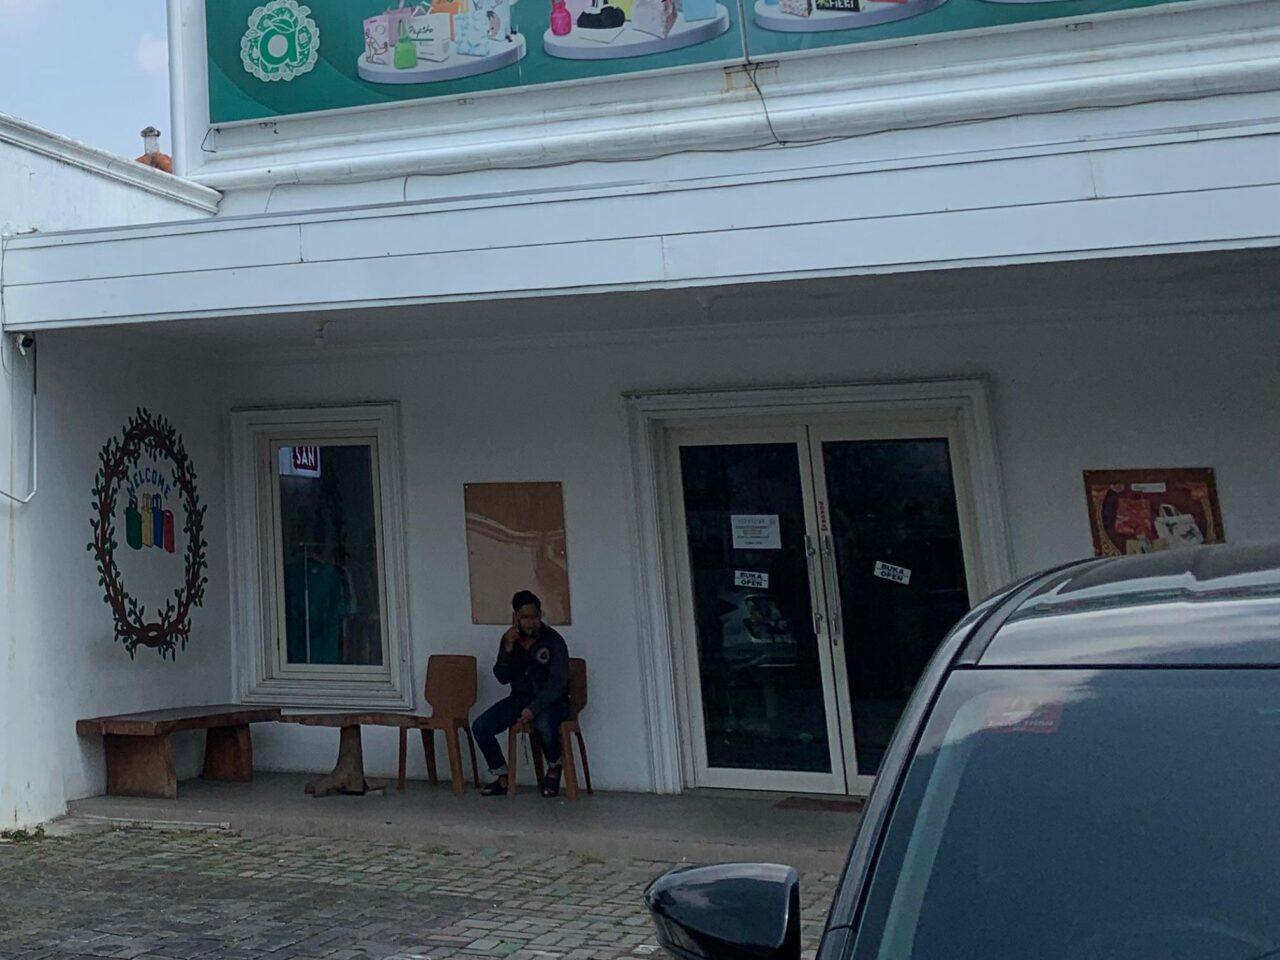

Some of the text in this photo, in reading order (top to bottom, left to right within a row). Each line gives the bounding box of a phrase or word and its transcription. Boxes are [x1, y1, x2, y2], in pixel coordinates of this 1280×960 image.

[295, 446, 315, 467] SAN
[126, 467, 171, 501] WELCOME
[881, 564, 904, 574] BUKA
[740, 572, 762, 580] BUKA
[880, 571, 903, 581] OPEN
[740, 579, 762, 587] OPEN
